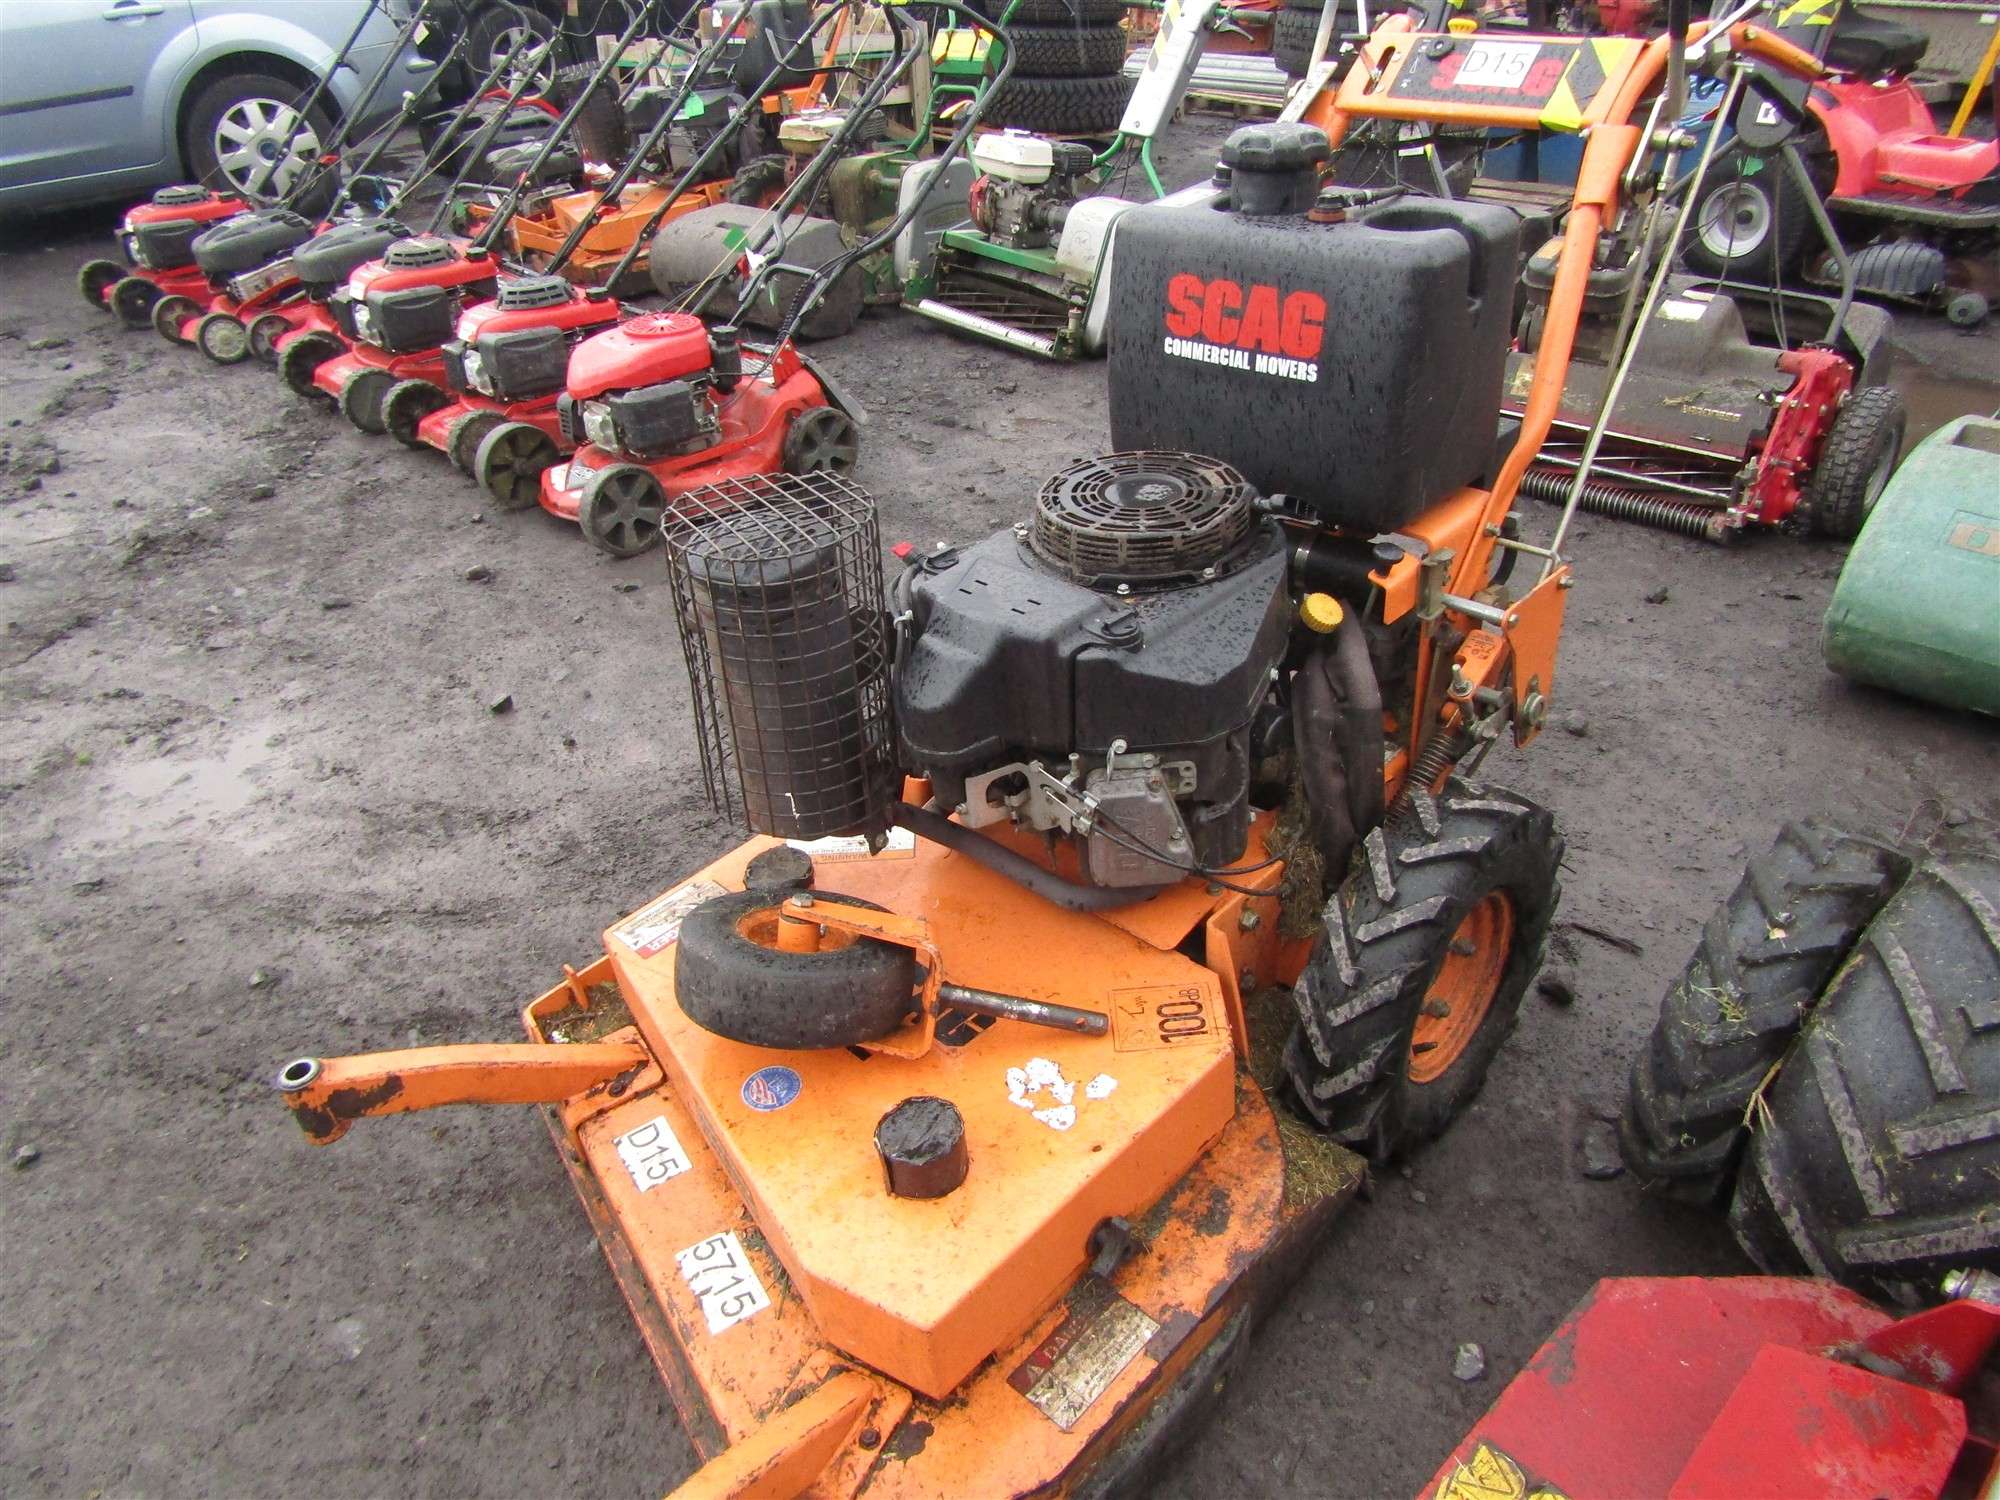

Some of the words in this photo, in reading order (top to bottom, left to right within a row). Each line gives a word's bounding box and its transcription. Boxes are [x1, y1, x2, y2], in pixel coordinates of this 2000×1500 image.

[1462, 50, 1525, 76] D15
[1166, 271, 1327, 359] SCAG
[1164, 336, 1250, 370] COMMERCIAL
[1255, 353, 1319, 383] MOWERS
[1156, 1000, 1208, 1043] 100
[626, 1122, 680, 1181] D15
[692, 1236, 757, 1318] 5715
